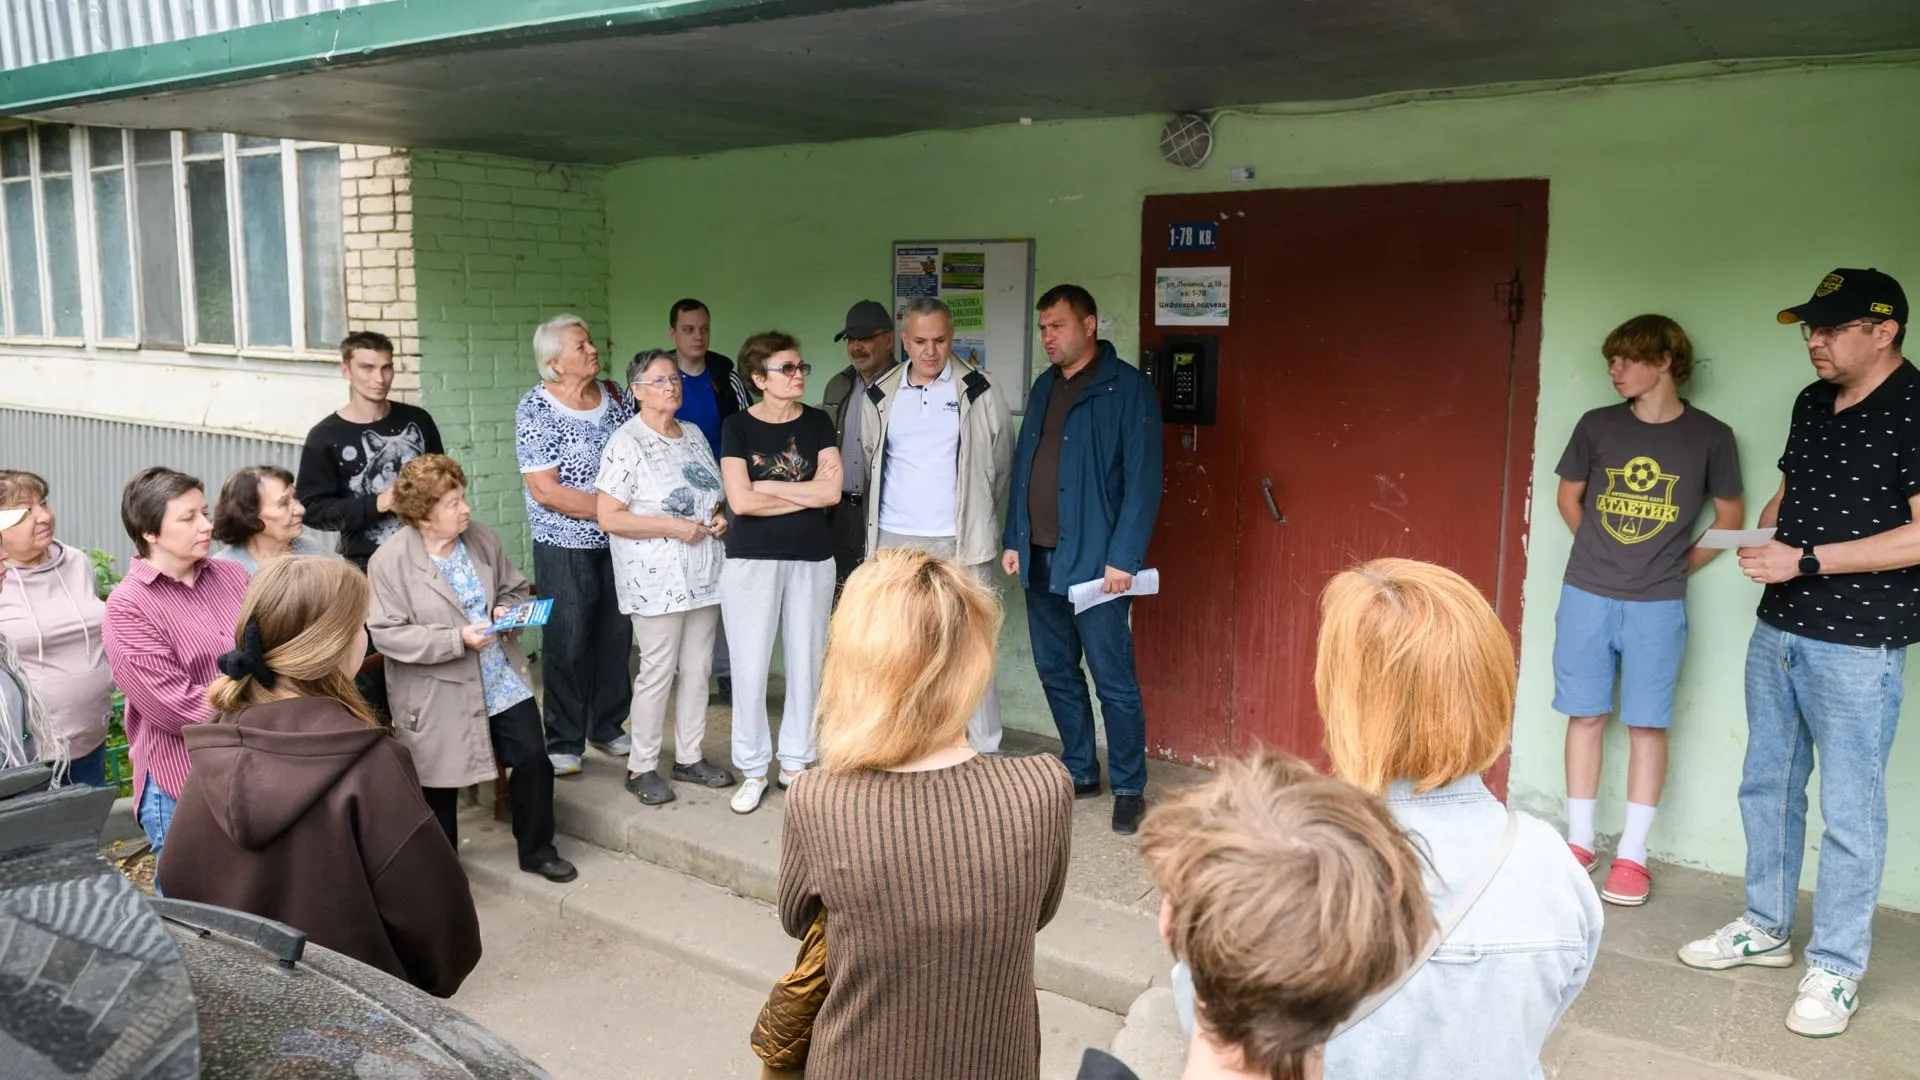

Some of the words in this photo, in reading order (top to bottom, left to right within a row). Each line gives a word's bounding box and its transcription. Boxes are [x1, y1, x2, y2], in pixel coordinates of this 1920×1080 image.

[1170, 227, 1192, 246] 1-78
[1158, 301, 1195, 309] Цифровой
[1598, 496, 1677, 521] АТЛЕТИК
